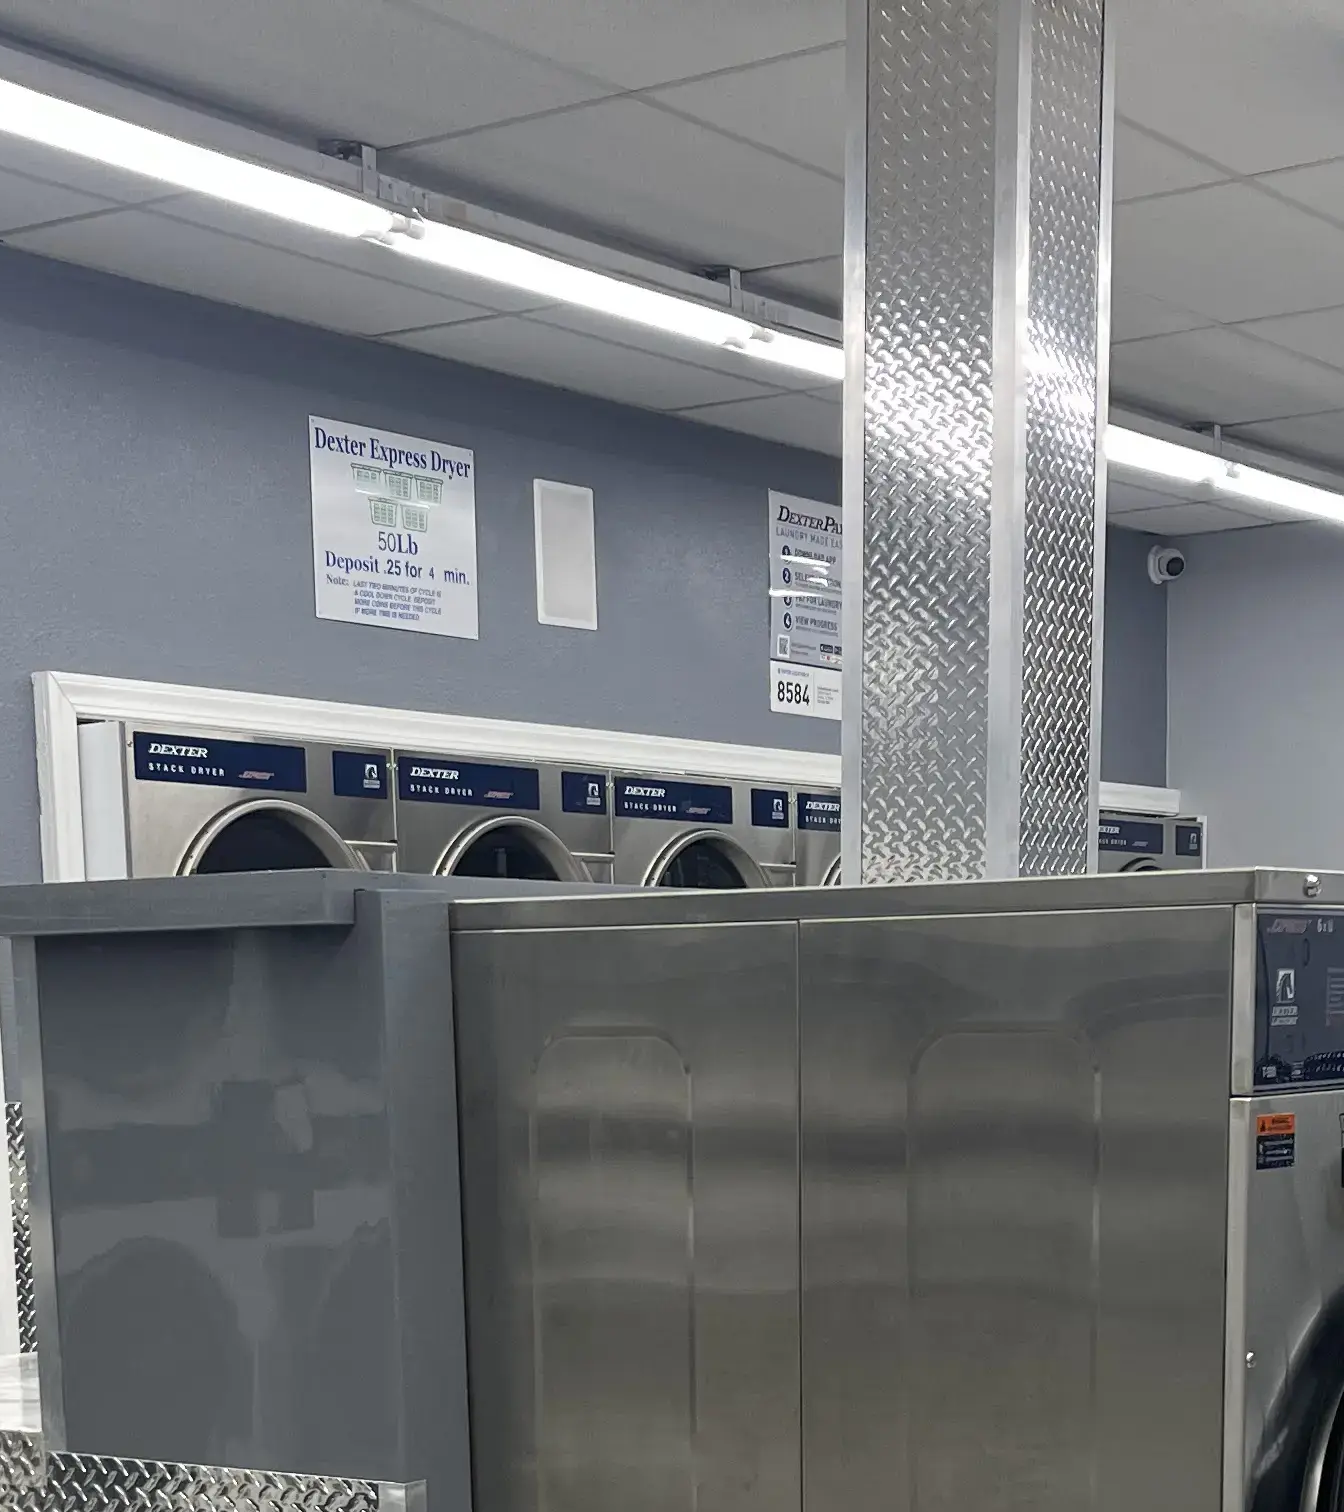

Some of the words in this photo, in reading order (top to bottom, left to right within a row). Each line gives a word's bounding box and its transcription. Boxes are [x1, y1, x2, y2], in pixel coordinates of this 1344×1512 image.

[314, 427, 367, 456] Dexter
[370, 438, 427, 469] Express
[431, 451, 471, 480] Dryer
[776, 526, 808, 540] LAUNDRY
[810, 534, 829, 546] MADE
[378, 531, 419, 556] 50Lb
[325, 550, 380, 574] Deposit
[383, 559, 402, 576] .25
[404, 562, 423, 579] for
[428, 566, 435, 580] 4
[444, 567, 470, 586] min.
[326, 573, 349, 586] Note:
[778, 681, 809, 706] 8584
[148, 743, 208, 759] DEXTER
[148, 762, 185, 774] STACK
[191, 764, 225, 777] DRYER
[410, 766, 459, 780] DEXTER
[410, 784, 440, 796] STACK
[444, 786, 474, 797] DRYER
[624, 786, 666, 798] DEXTER
[624, 801, 649, 811] STACK
[653, 803, 677, 813] DRYER
[806, 801, 840, 812] DEXTER
[829, 816, 842, 825] DRY
[1098, 825, 1120, 834] EXTER
